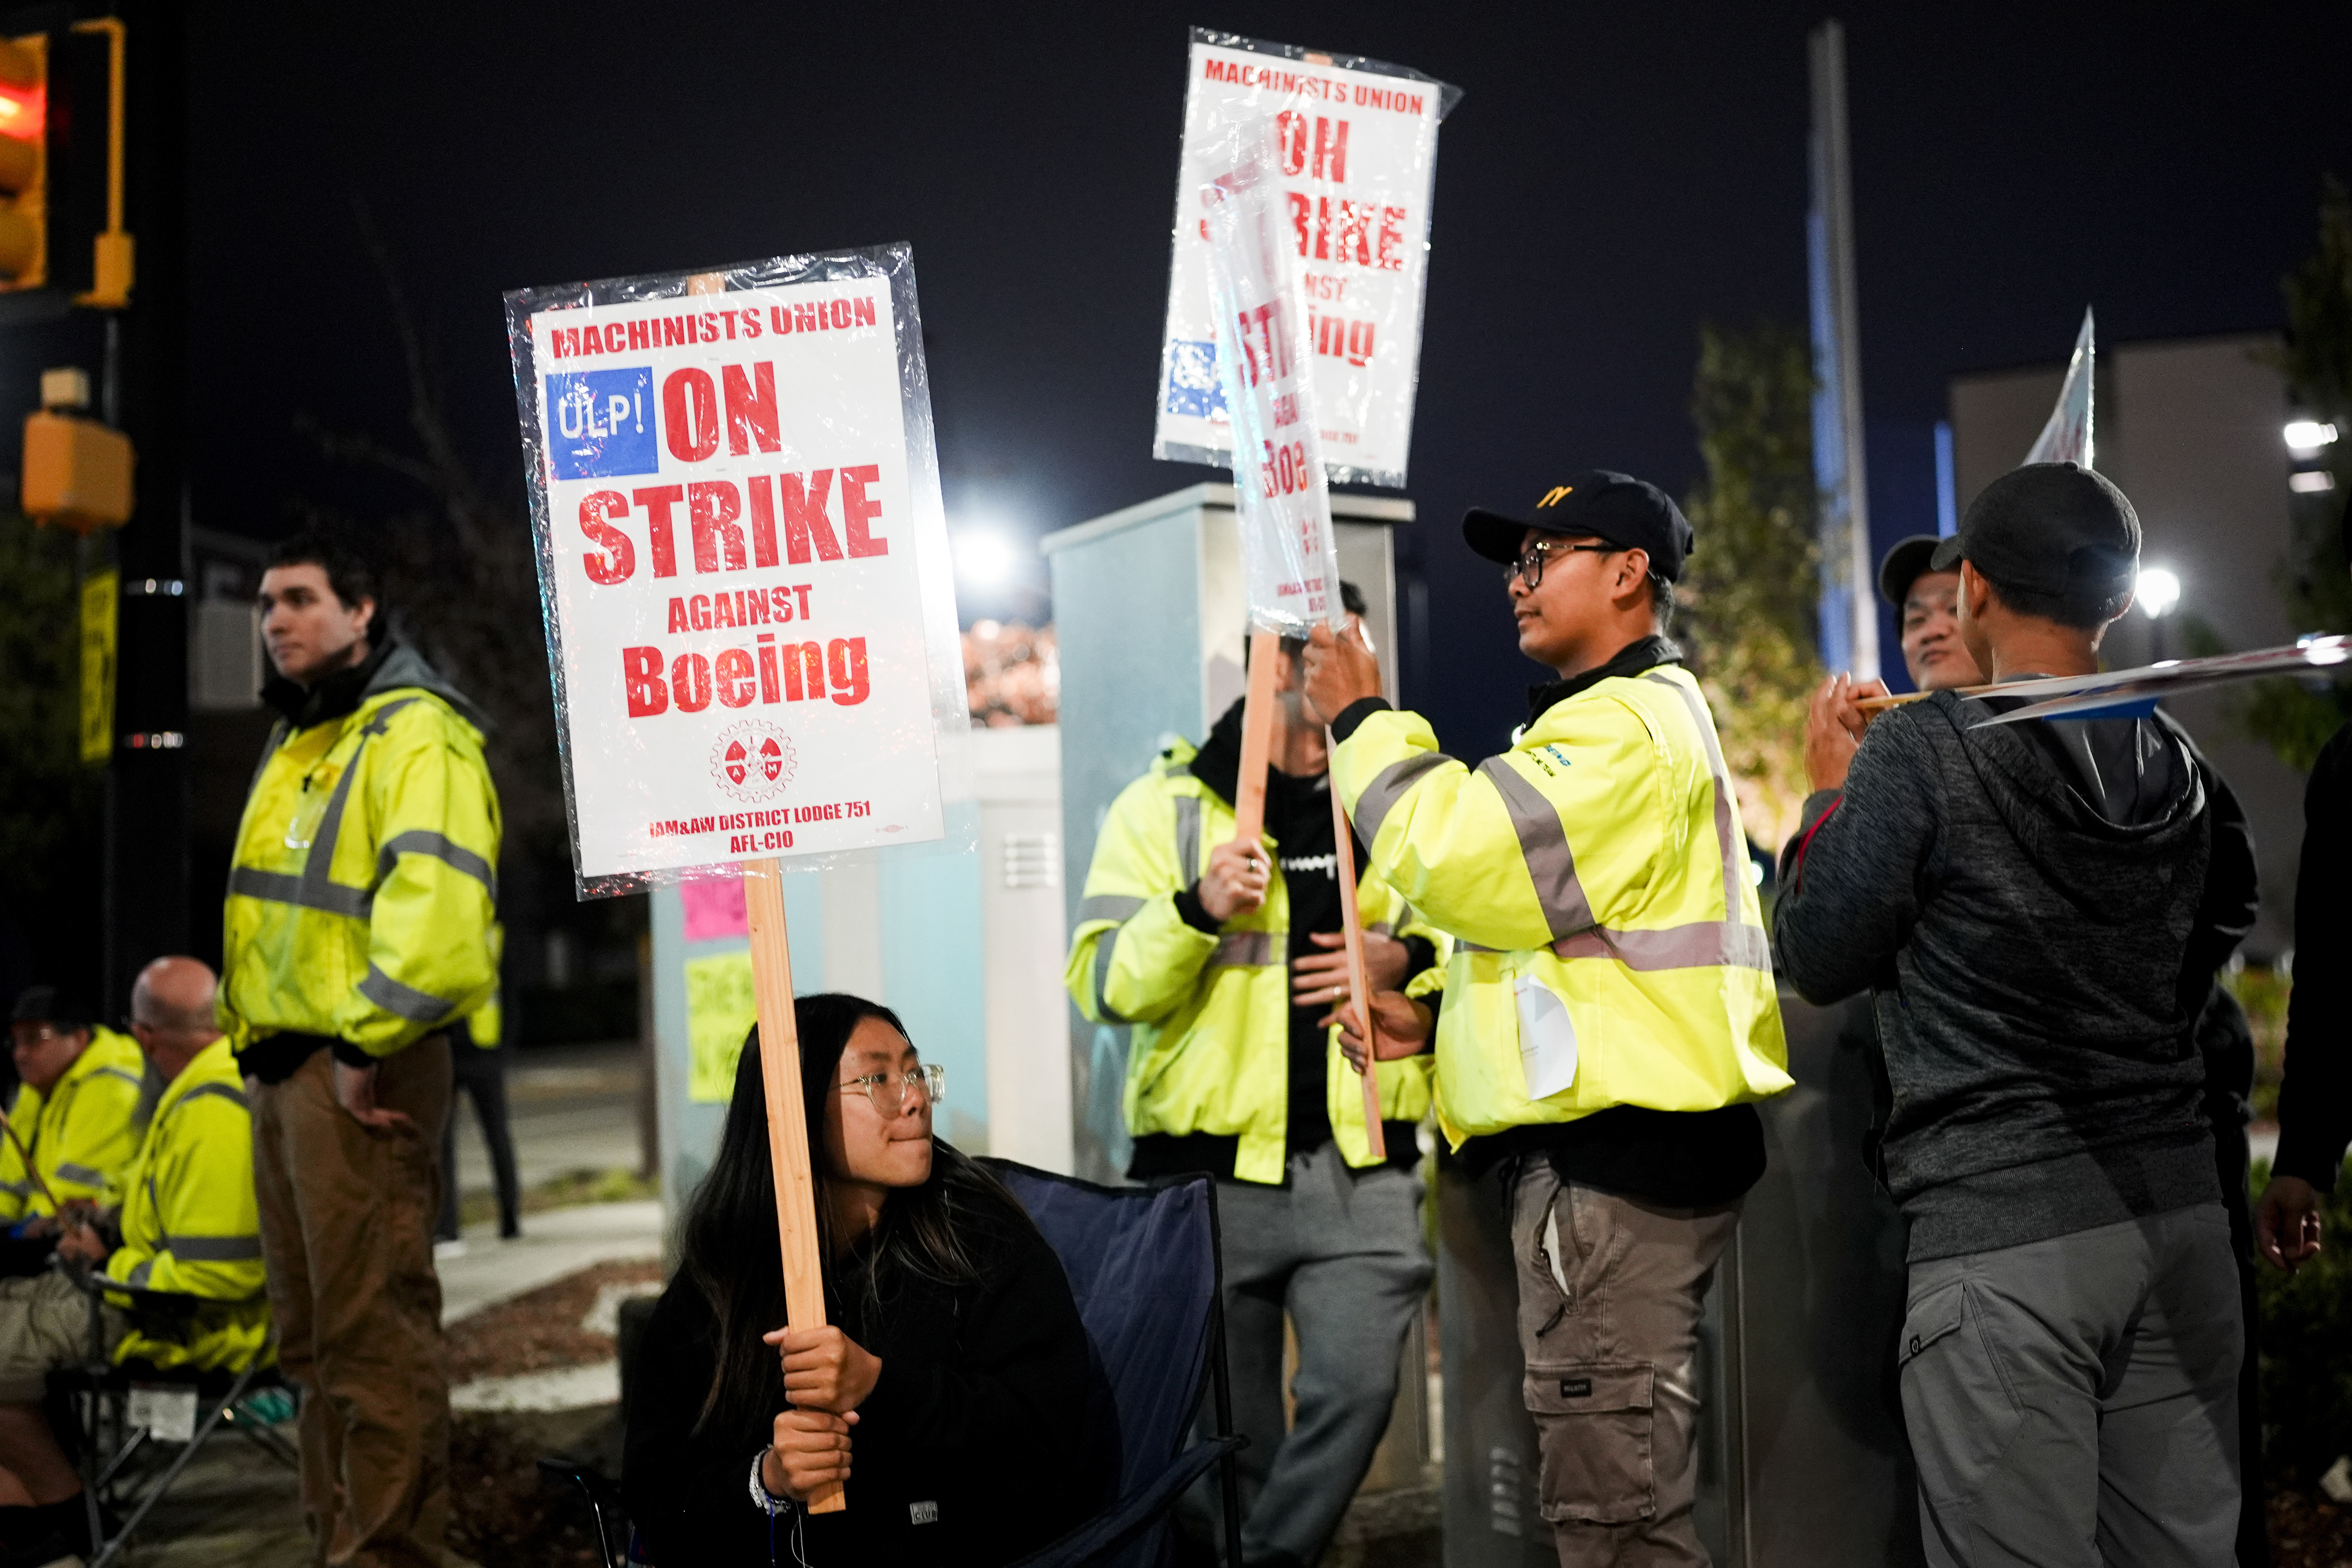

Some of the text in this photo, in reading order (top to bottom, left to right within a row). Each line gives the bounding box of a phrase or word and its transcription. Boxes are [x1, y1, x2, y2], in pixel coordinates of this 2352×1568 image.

[1206, 59, 1422, 115] MACHINISTS UNION
[1277, 111, 1348, 183] ON
[552, 298, 876, 358] MACHINISTS UNION
[559, 390, 644, 439] ULP!
[663, 361, 781, 462] ON
[579, 464, 888, 585] STRIKE
[668, 584, 812, 633] AGAINST
[623, 635, 870, 718] Boeing
[649, 801, 870, 838] IAM&AW DISTRICT LODGE 751
[731, 831, 793, 853] AFL-CIO
